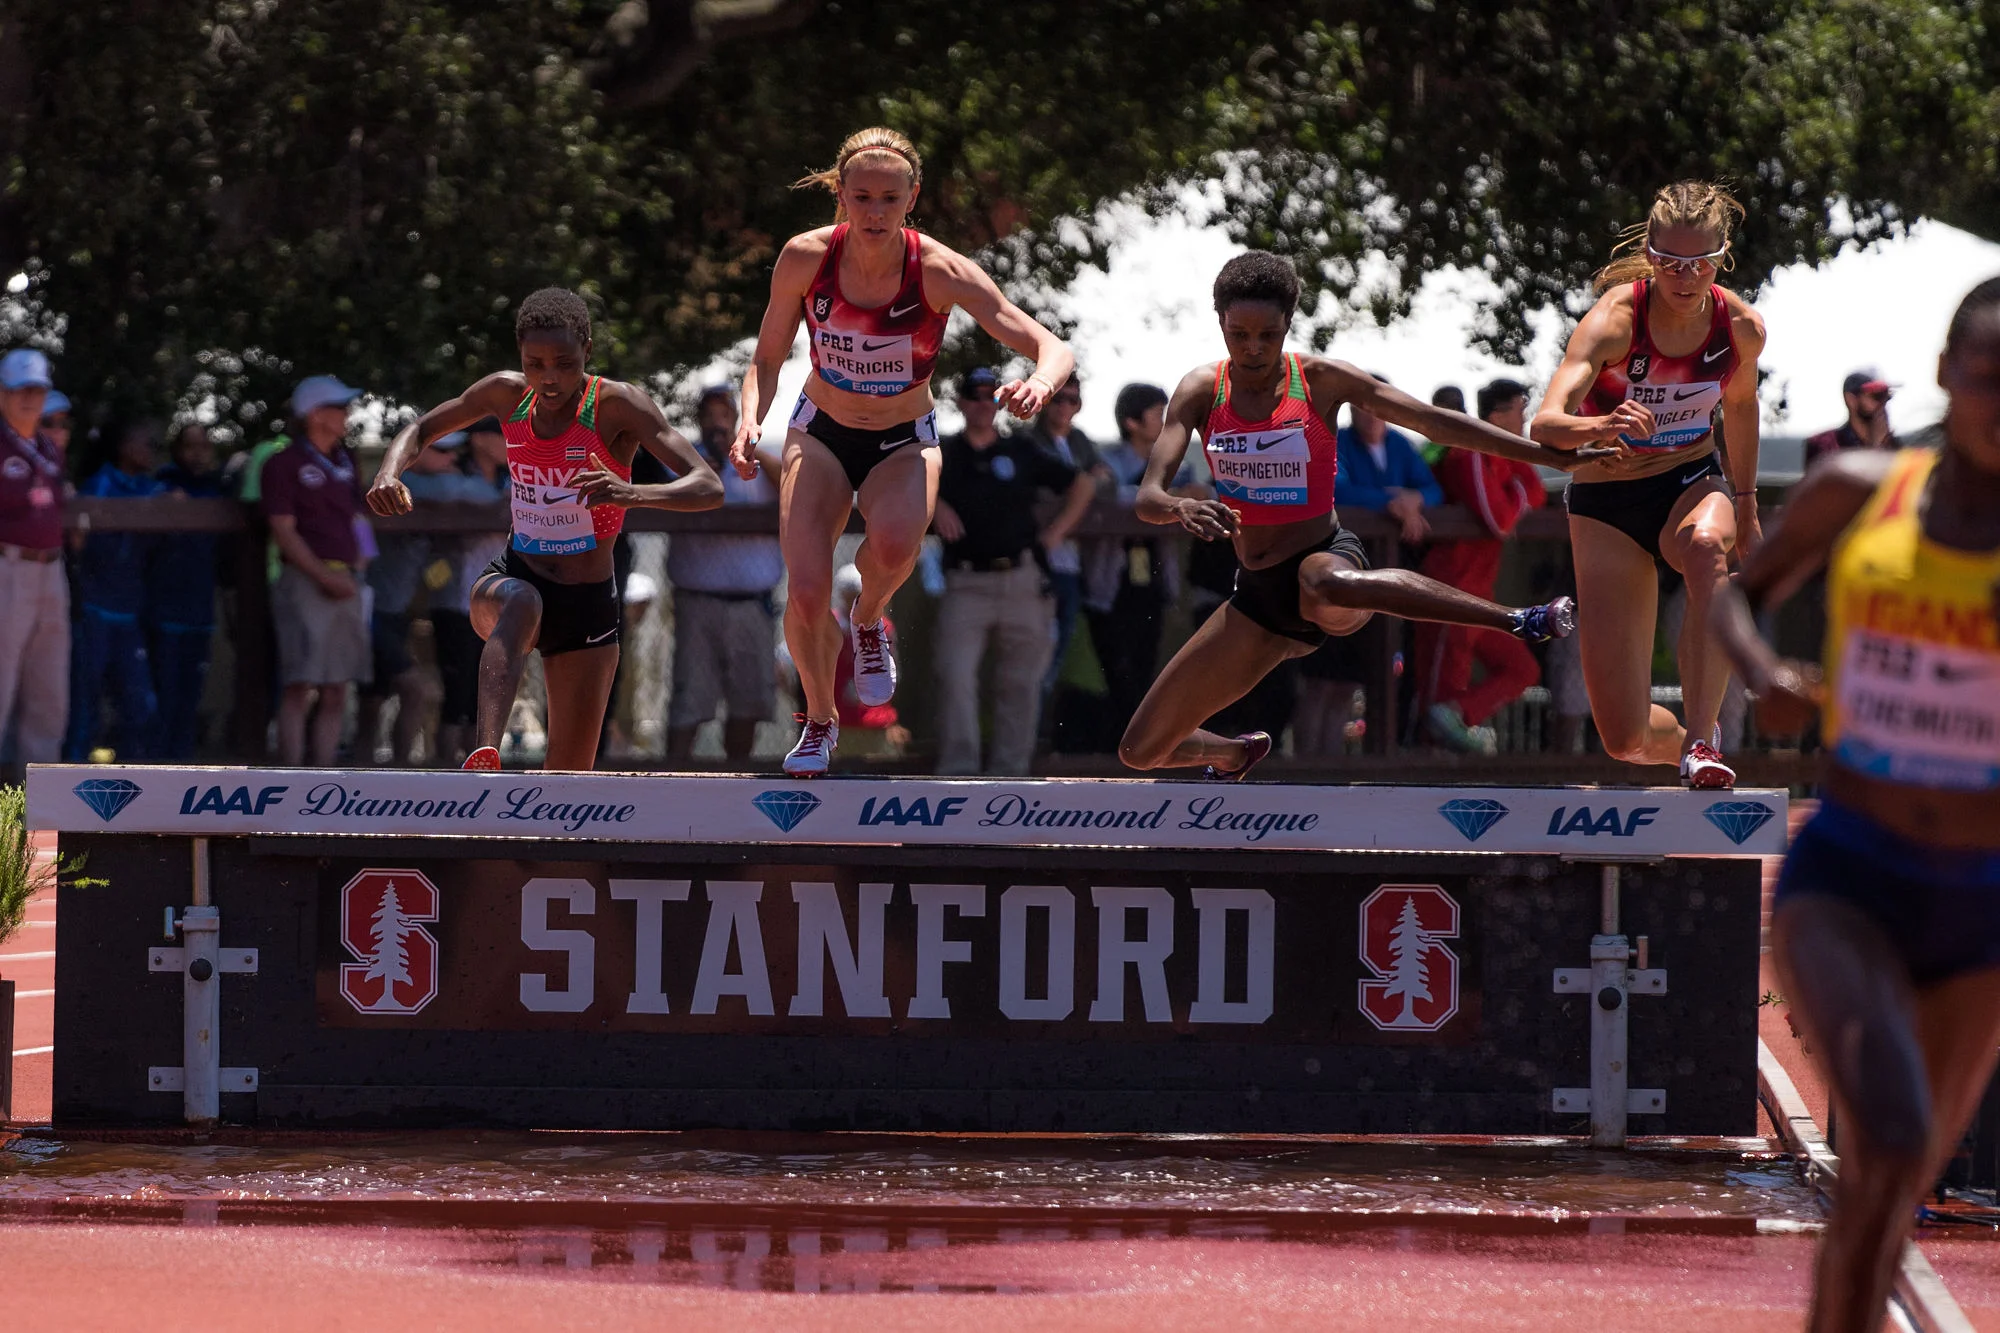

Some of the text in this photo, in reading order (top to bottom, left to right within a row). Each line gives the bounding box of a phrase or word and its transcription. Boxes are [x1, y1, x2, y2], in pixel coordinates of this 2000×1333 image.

[821, 332, 853, 352] PRE
[827, 353, 904, 375] FRERICHS
[852, 382, 904, 394] Eugene
[1632, 386, 1667, 404] PRE
[1215, 436, 1247, 453] PRE
[1651, 433, 1701, 445] Eugene
[1219, 459, 1300, 479] CHEPNGETICH
[513, 483, 536, 504] PRE
[1247, 488, 1298, 503] Eugene
[515, 509, 580, 527] CHEPKURUI
[539, 540, 587, 554] Eugene
[180, 782, 636, 832] IAAF Diamond League
[858, 793, 1319, 842] IAAF Diamond League
[1547, 806, 1660, 836] IAAF
[519, 878, 1275, 1024] STANFORD
